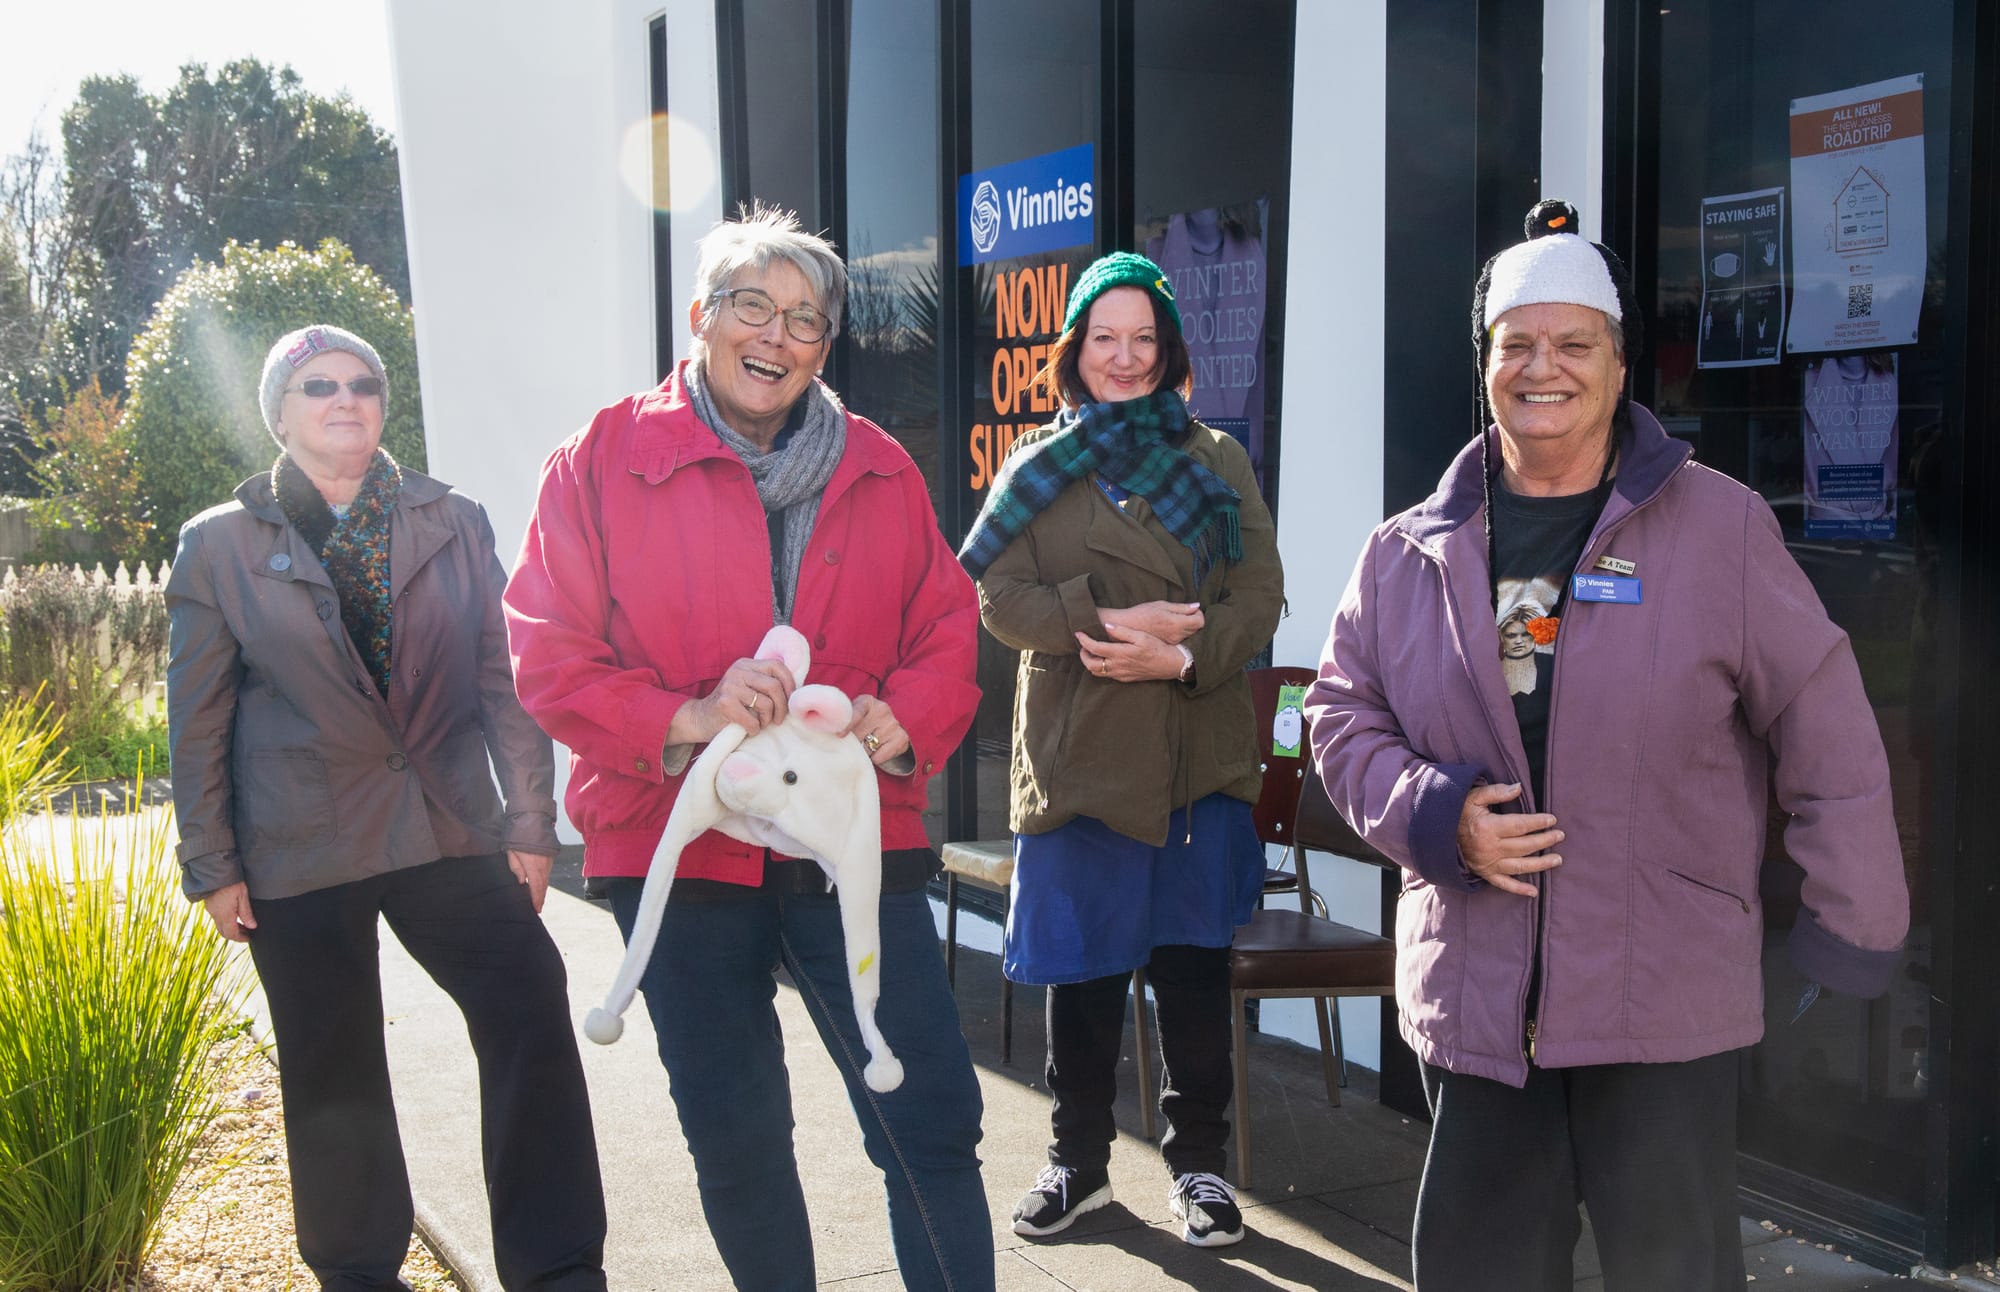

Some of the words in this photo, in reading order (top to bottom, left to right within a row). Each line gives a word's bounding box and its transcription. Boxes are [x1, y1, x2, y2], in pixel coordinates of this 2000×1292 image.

[1832, 110, 1853, 122] ALL
[1854, 102, 1882, 117] NEW!
[1823, 123, 1839, 134] THE
[1839, 120, 1857, 131] NEW
[1859, 113, 1893, 128] JONESES
[1823, 123, 1892, 150] ROADTRIP
[1006, 178, 1093, 231] Vinnies
[1706, 207, 1753, 225] STAYING
[1754, 204, 1777, 219] SAFE
[996, 264, 1068, 339] NOW
[1180, 306, 1257, 344] OOLIES
[1813, 383, 1892, 404] WINTER
[1813, 406, 1890, 427] WOOLIES
[1812, 430, 1891, 450] WANTED
[1615, 562, 1634, 571] Team
[1587, 579, 1614, 587] Vinnies
